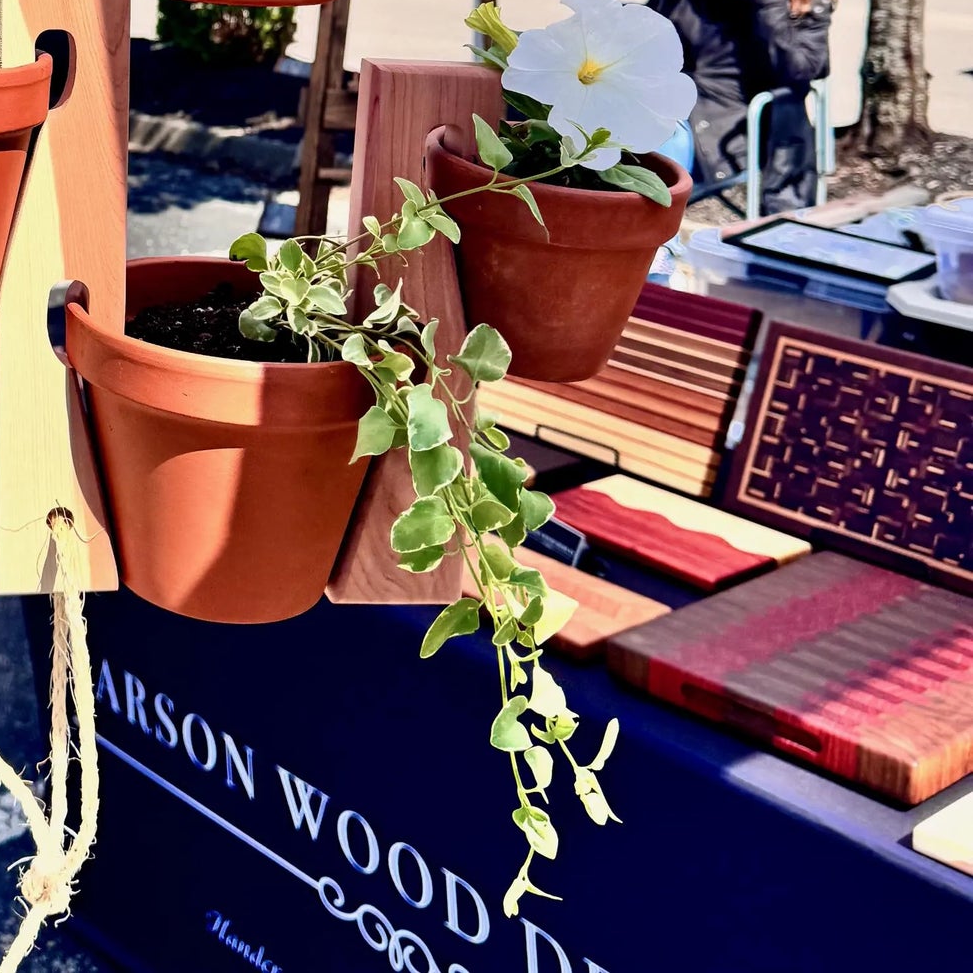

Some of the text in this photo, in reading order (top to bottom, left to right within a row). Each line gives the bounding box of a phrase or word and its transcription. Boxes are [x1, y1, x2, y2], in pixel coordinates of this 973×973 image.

[96, 658, 610, 973] ARSON WOOD D
